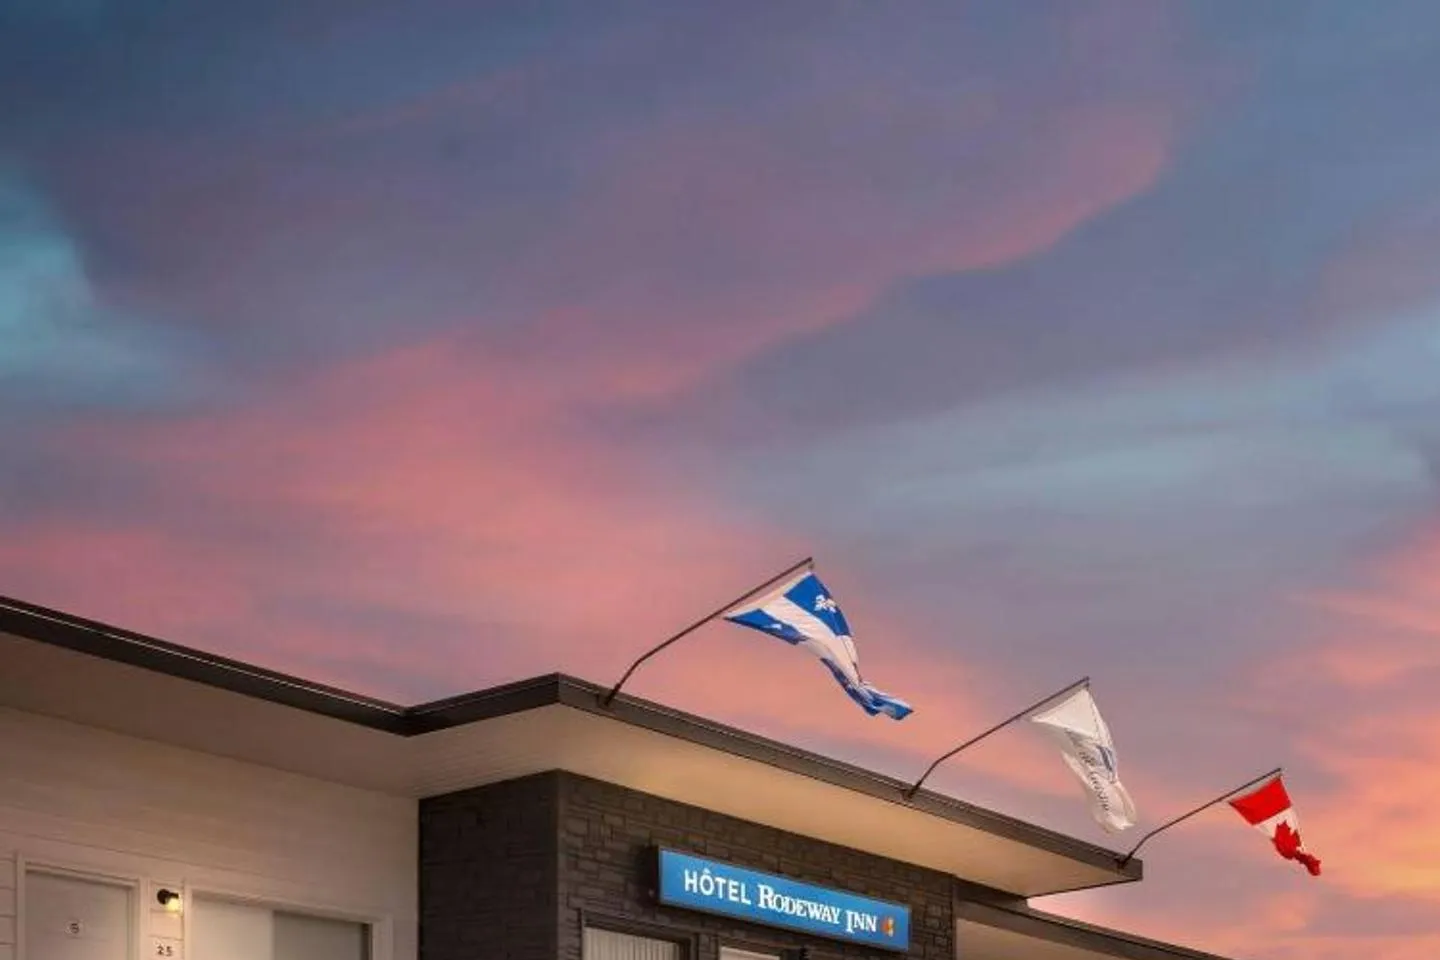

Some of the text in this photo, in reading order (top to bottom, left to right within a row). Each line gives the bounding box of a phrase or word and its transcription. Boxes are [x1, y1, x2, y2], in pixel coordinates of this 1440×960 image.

[684, 868, 877, 933] HÔTEL RODEWAY INN
